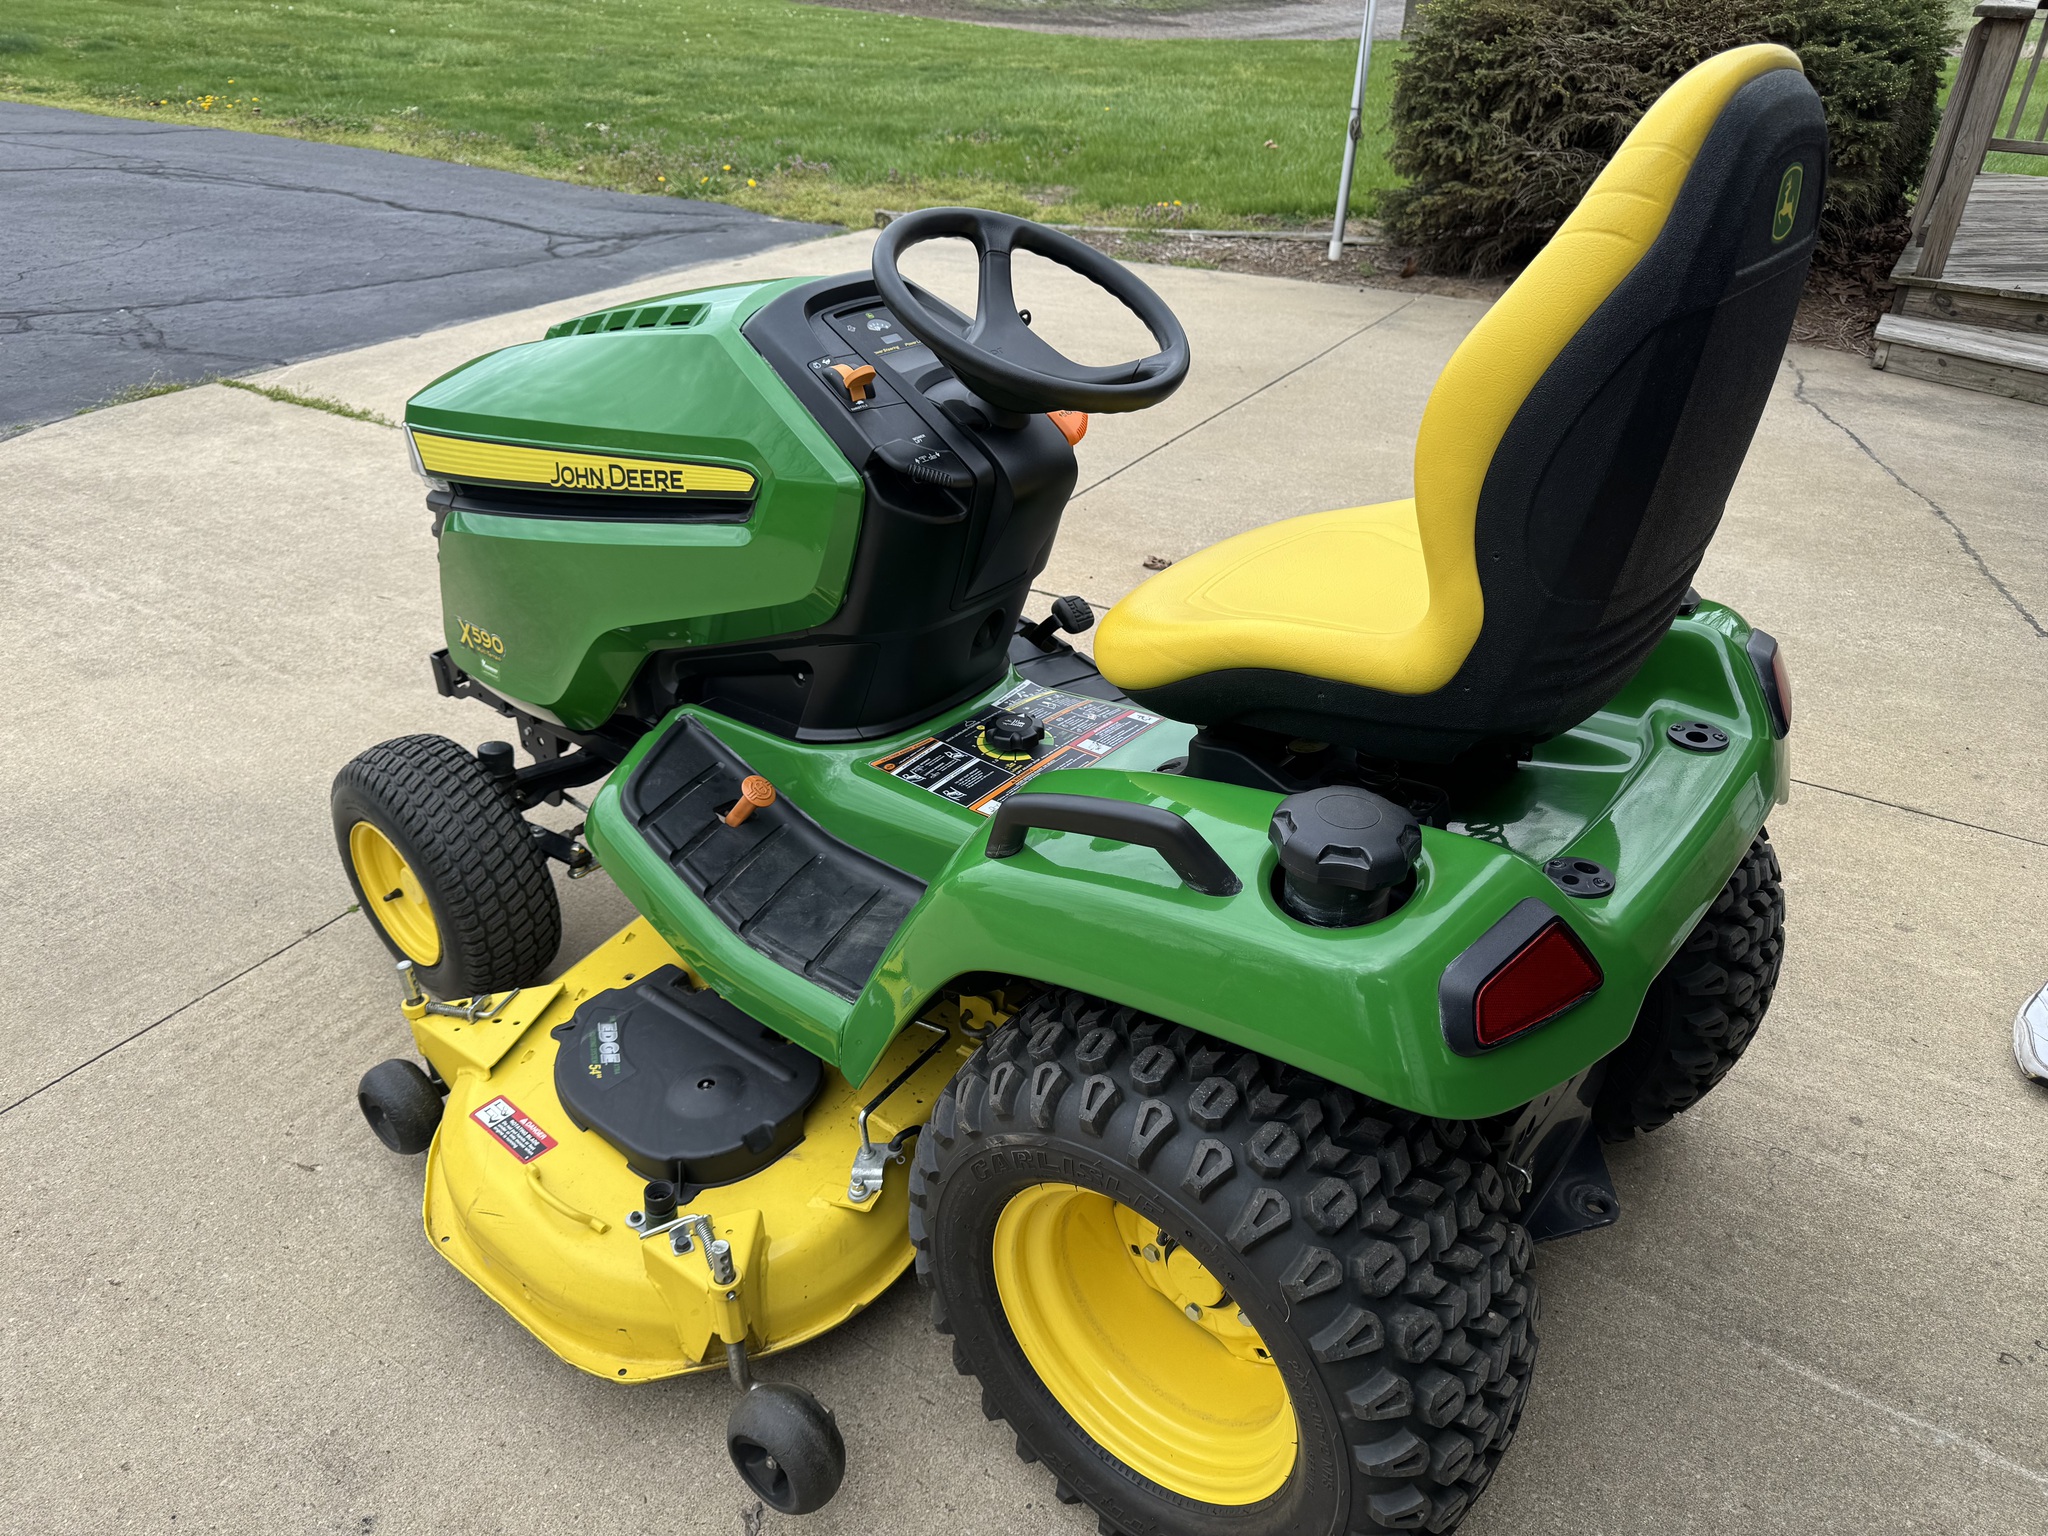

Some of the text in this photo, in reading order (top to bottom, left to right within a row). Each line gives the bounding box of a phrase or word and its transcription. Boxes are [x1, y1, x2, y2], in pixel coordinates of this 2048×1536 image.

[550, 461, 685, 490] JOHN DEERE
[457, 618, 504, 654] X590
[597, 1021, 620, 1064] EDGE
[524, 1120, 547, 1140] DANGER
[970, 1149, 1165, 1225] CARLISLE
